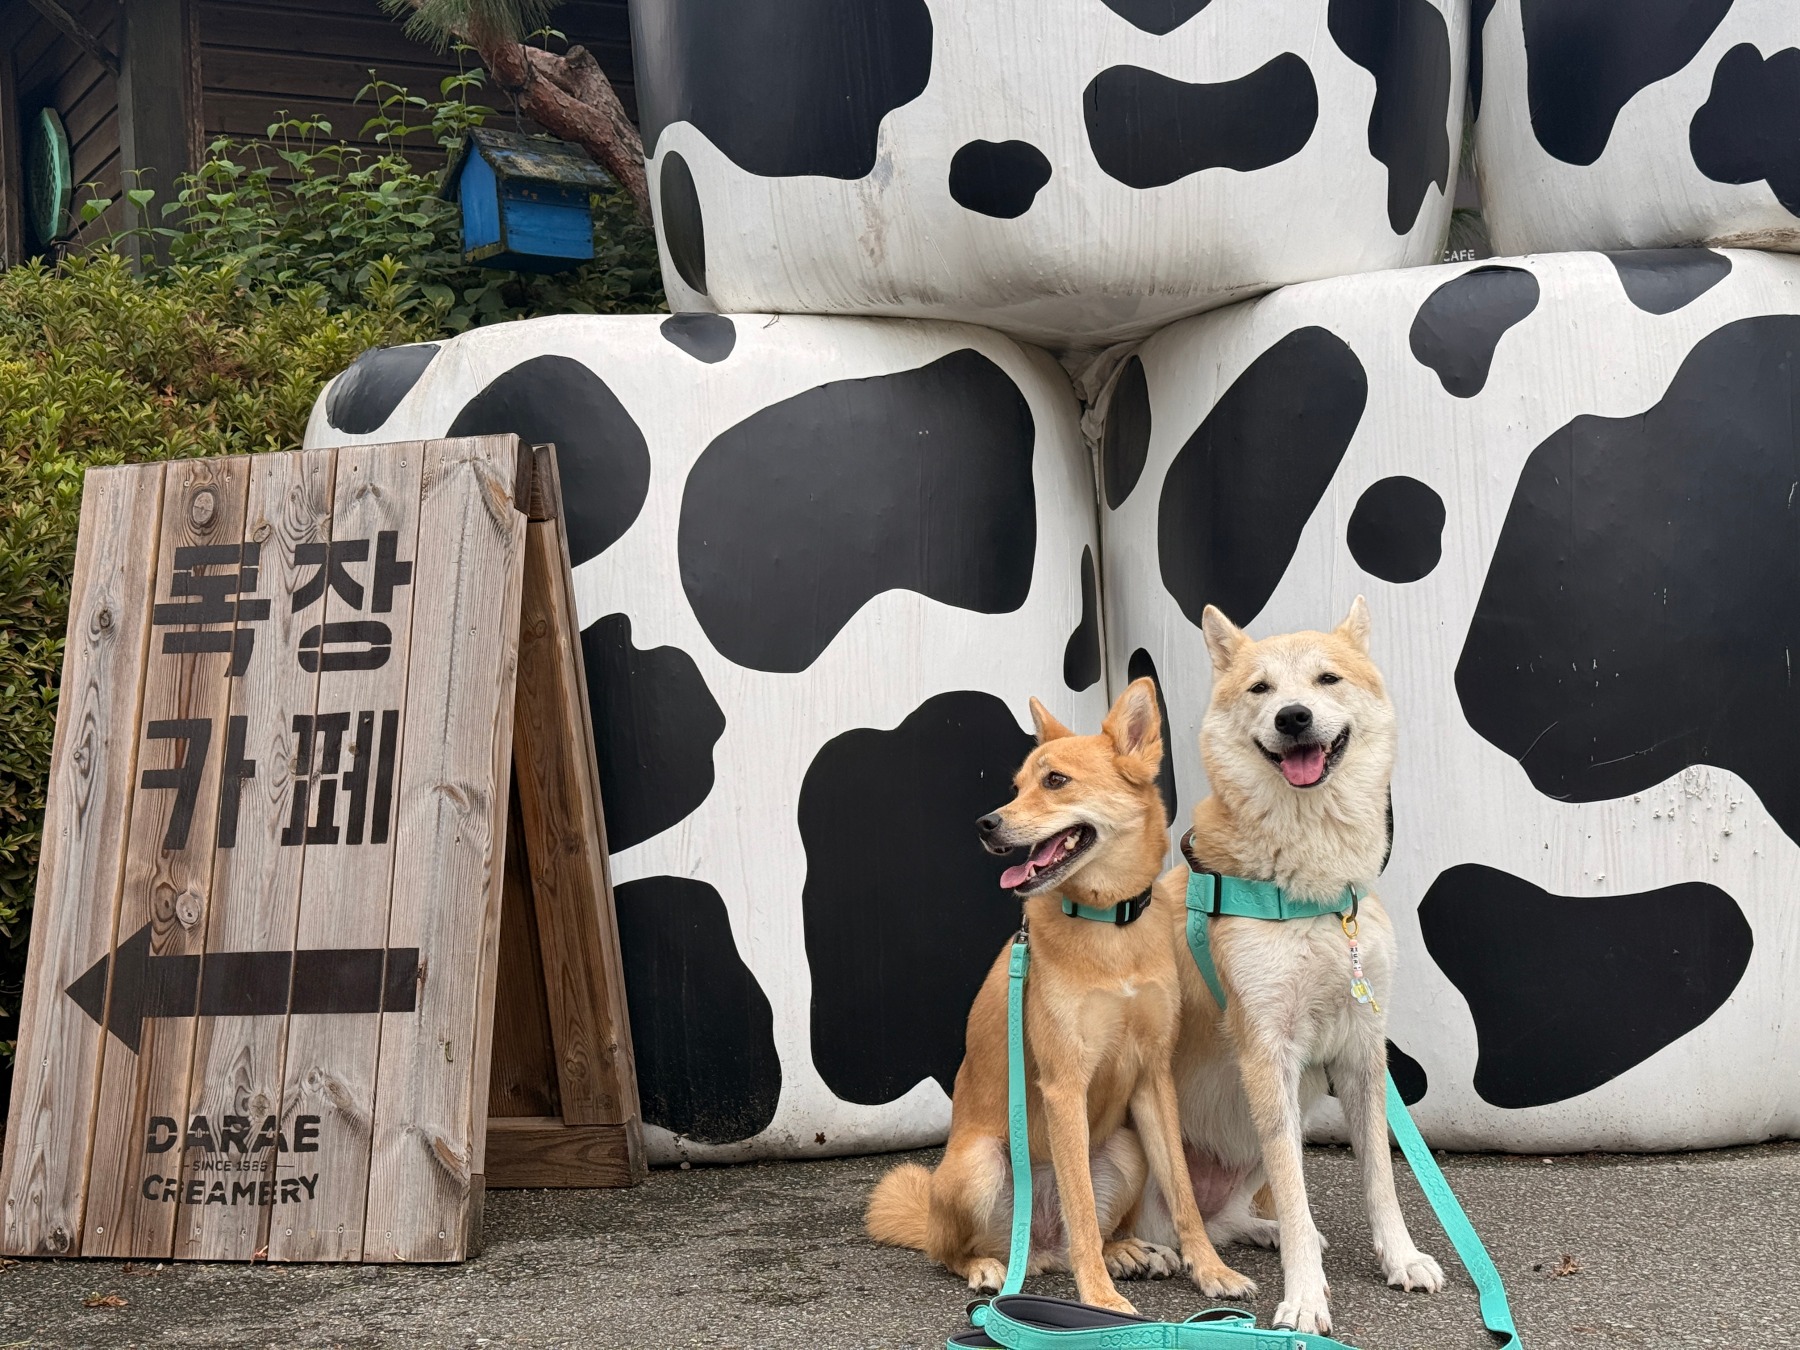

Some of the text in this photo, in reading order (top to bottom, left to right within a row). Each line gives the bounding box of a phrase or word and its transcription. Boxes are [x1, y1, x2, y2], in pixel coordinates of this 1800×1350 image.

[1443, 249, 1475, 262] CAFE
[153, 529, 413, 678] 목장
[141, 709, 399, 850] 카페
[146, 1114, 321, 1154] DARAE
[192, 1160, 232, 1172] SINCE
[141, 1173, 320, 1206] CREAMERY
